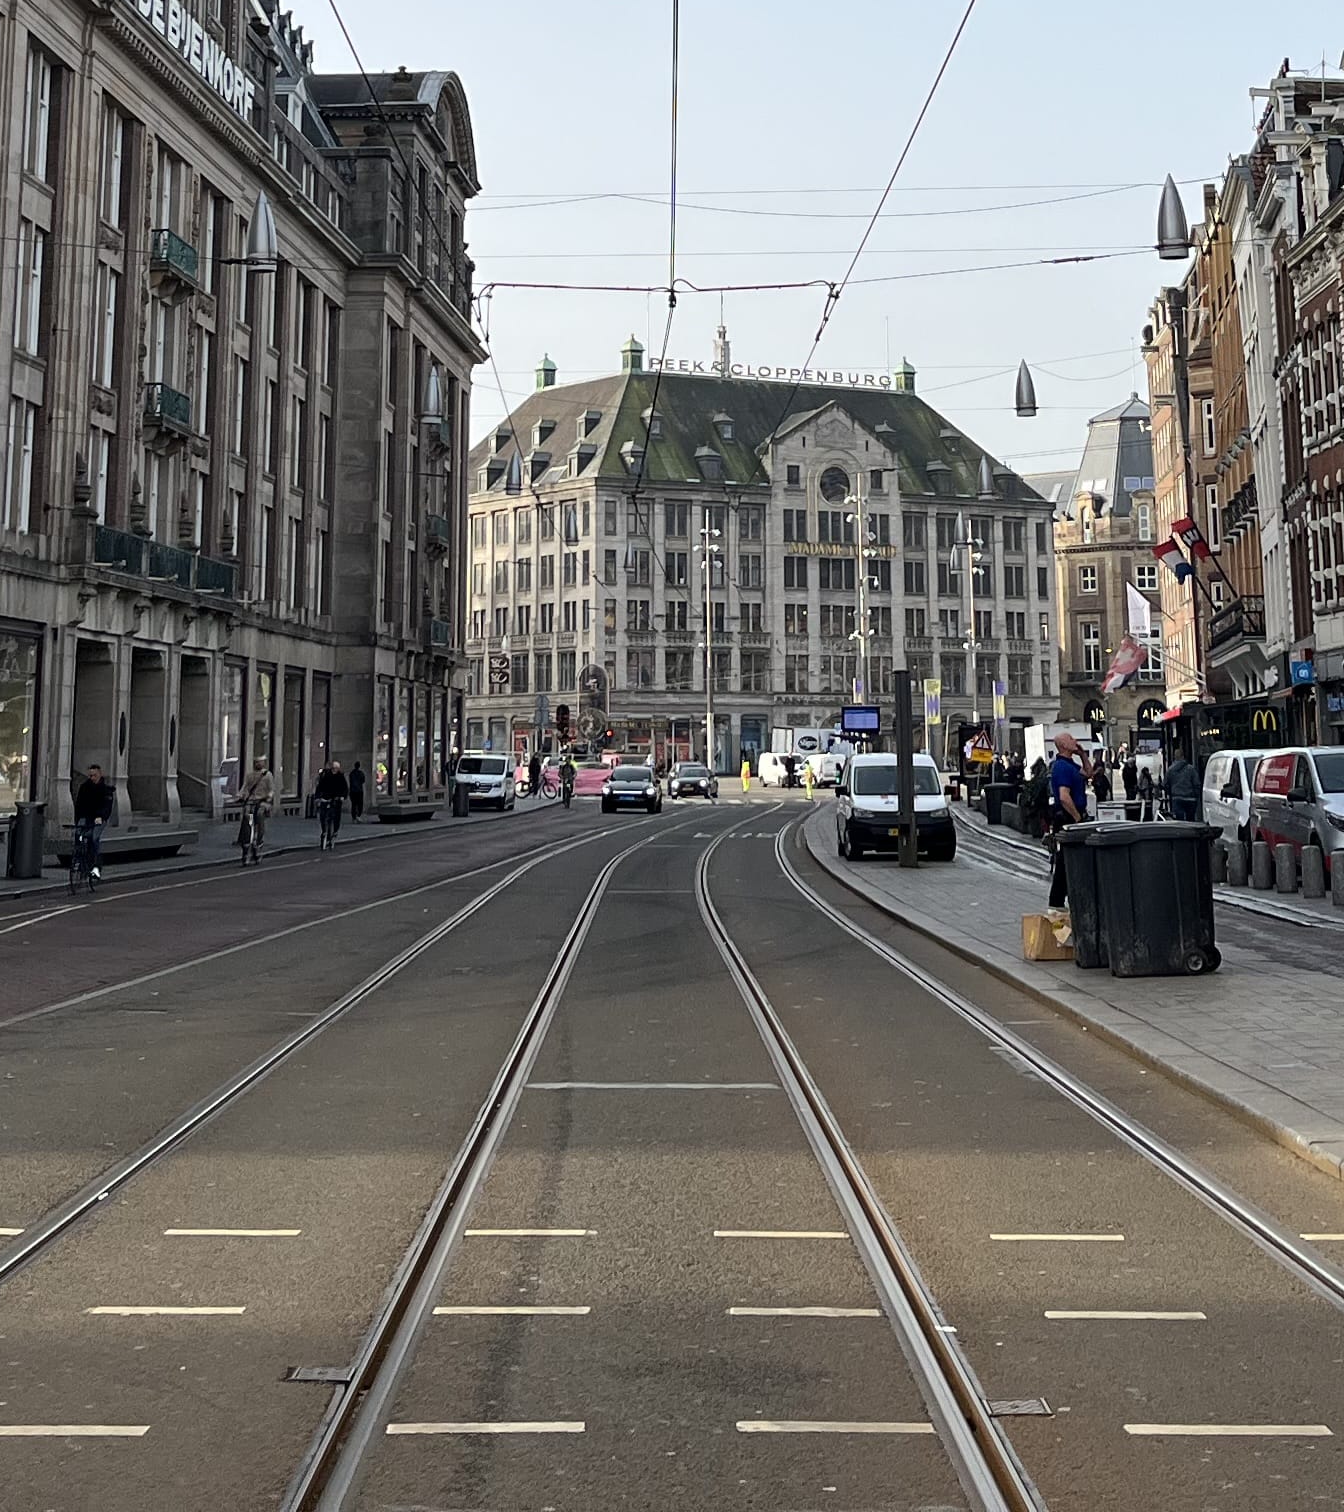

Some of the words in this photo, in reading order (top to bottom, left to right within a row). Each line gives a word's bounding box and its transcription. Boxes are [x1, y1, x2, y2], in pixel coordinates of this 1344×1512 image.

[649, 357, 704, 373] PEEK
[711, 360, 724, 373] &
[731, 363, 892, 387] CLOPPENBURG
